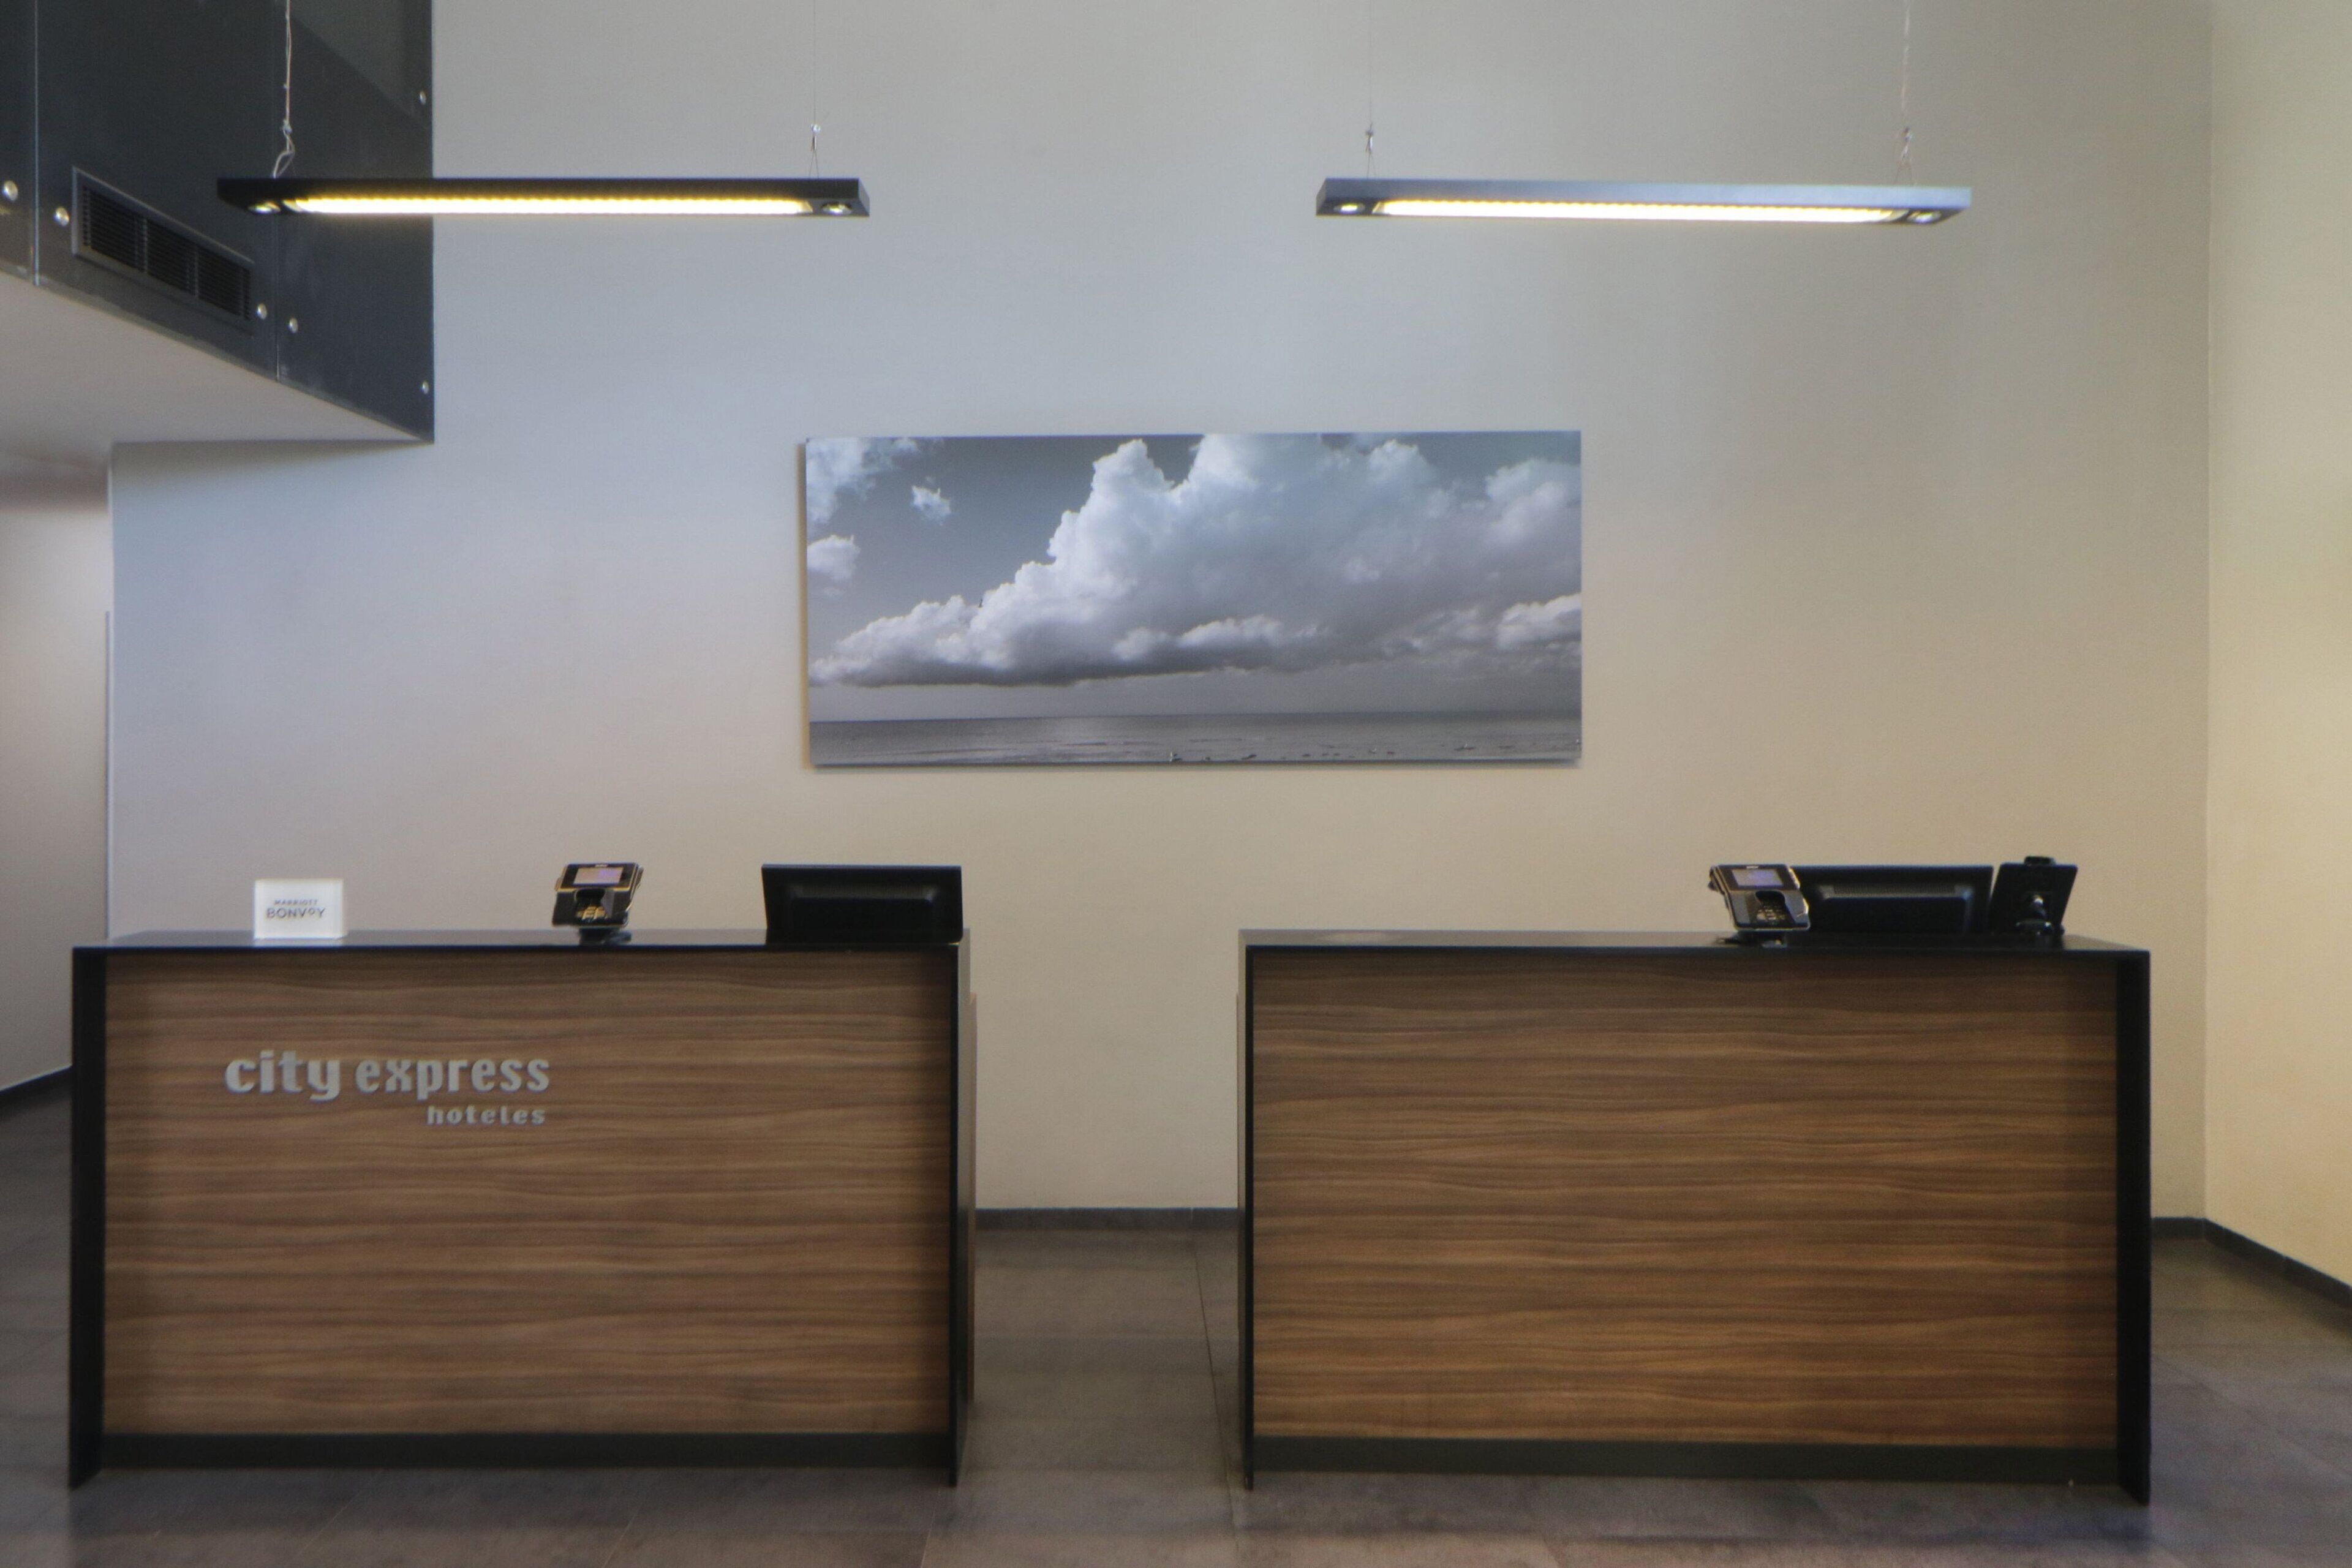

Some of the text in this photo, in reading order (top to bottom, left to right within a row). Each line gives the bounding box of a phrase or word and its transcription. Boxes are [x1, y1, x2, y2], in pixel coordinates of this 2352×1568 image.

[266, 908, 325, 919] BONVOY
[225, 1049, 550, 1101] city express
[427, 1106, 546, 1126] hoteles
